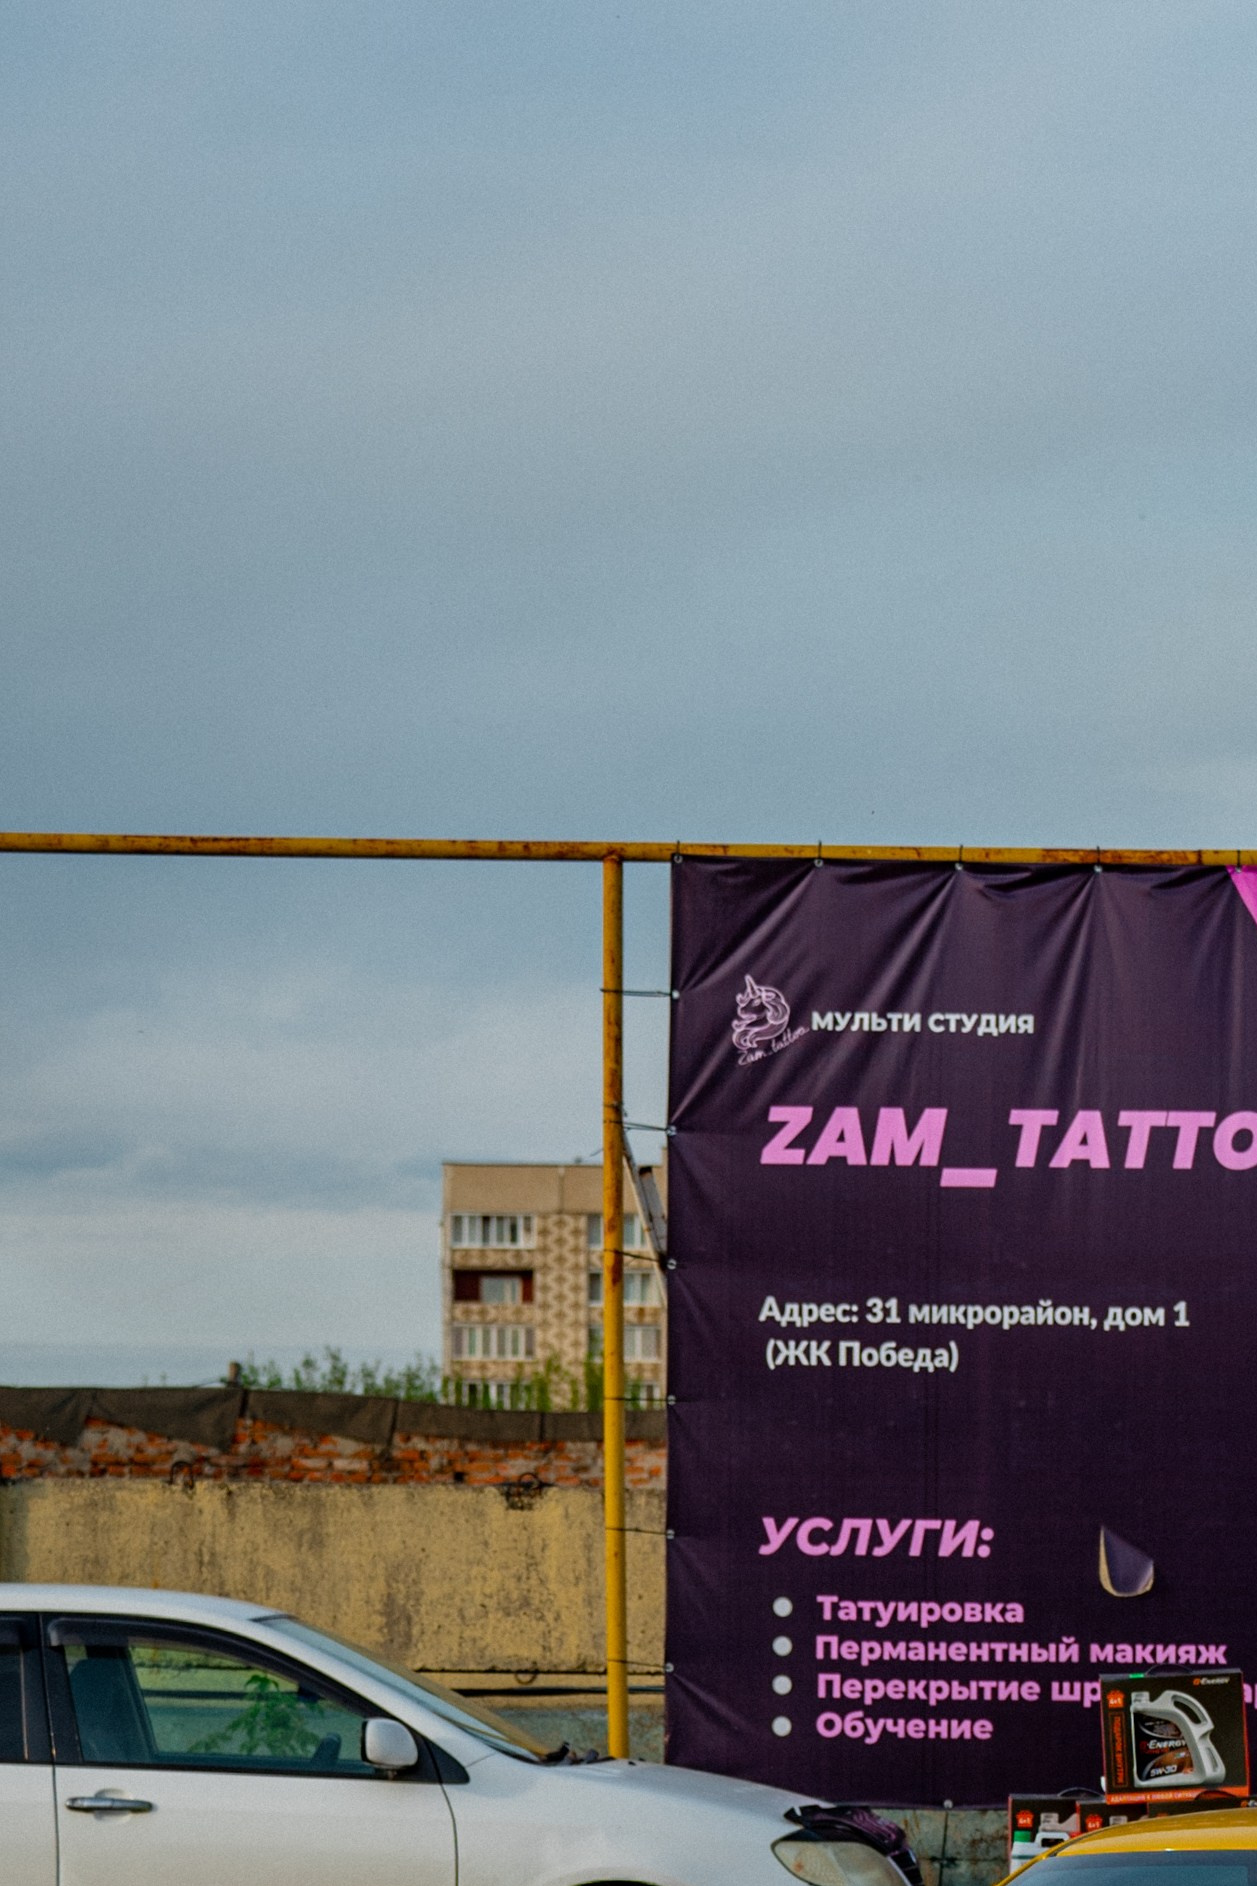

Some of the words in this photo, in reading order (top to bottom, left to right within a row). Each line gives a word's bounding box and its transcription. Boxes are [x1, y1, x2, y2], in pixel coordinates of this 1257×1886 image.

[811, 1011, 922, 1033] МУЛЬТИ
[927, 1012, 1034, 1037] СТУДИЯ
[758, 1295, 859, 1328] Адрес:
[865, 1297, 901, 1324] 31
[908, 1299, 1098, 1330] микрорайон,
[1103, 1306, 1165, 1332] дом
[1173, 1301, 1190, 1327] 1
[765, 1338, 832, 1371] (ЖК
[838, 1340, 960, 1372] Победа)
[758, 1517, 994, 1558] УСЛУГИ:
[816, 1595, 1024, 1628] Татуировка
[815, 1635, 1079, 1667] Перманентный
[1090, 1643, 1227, 1665] макияж
[817, 1673, 1041, 1706] Перекрытие
[816, 1711, 994, 1743] Обучение
